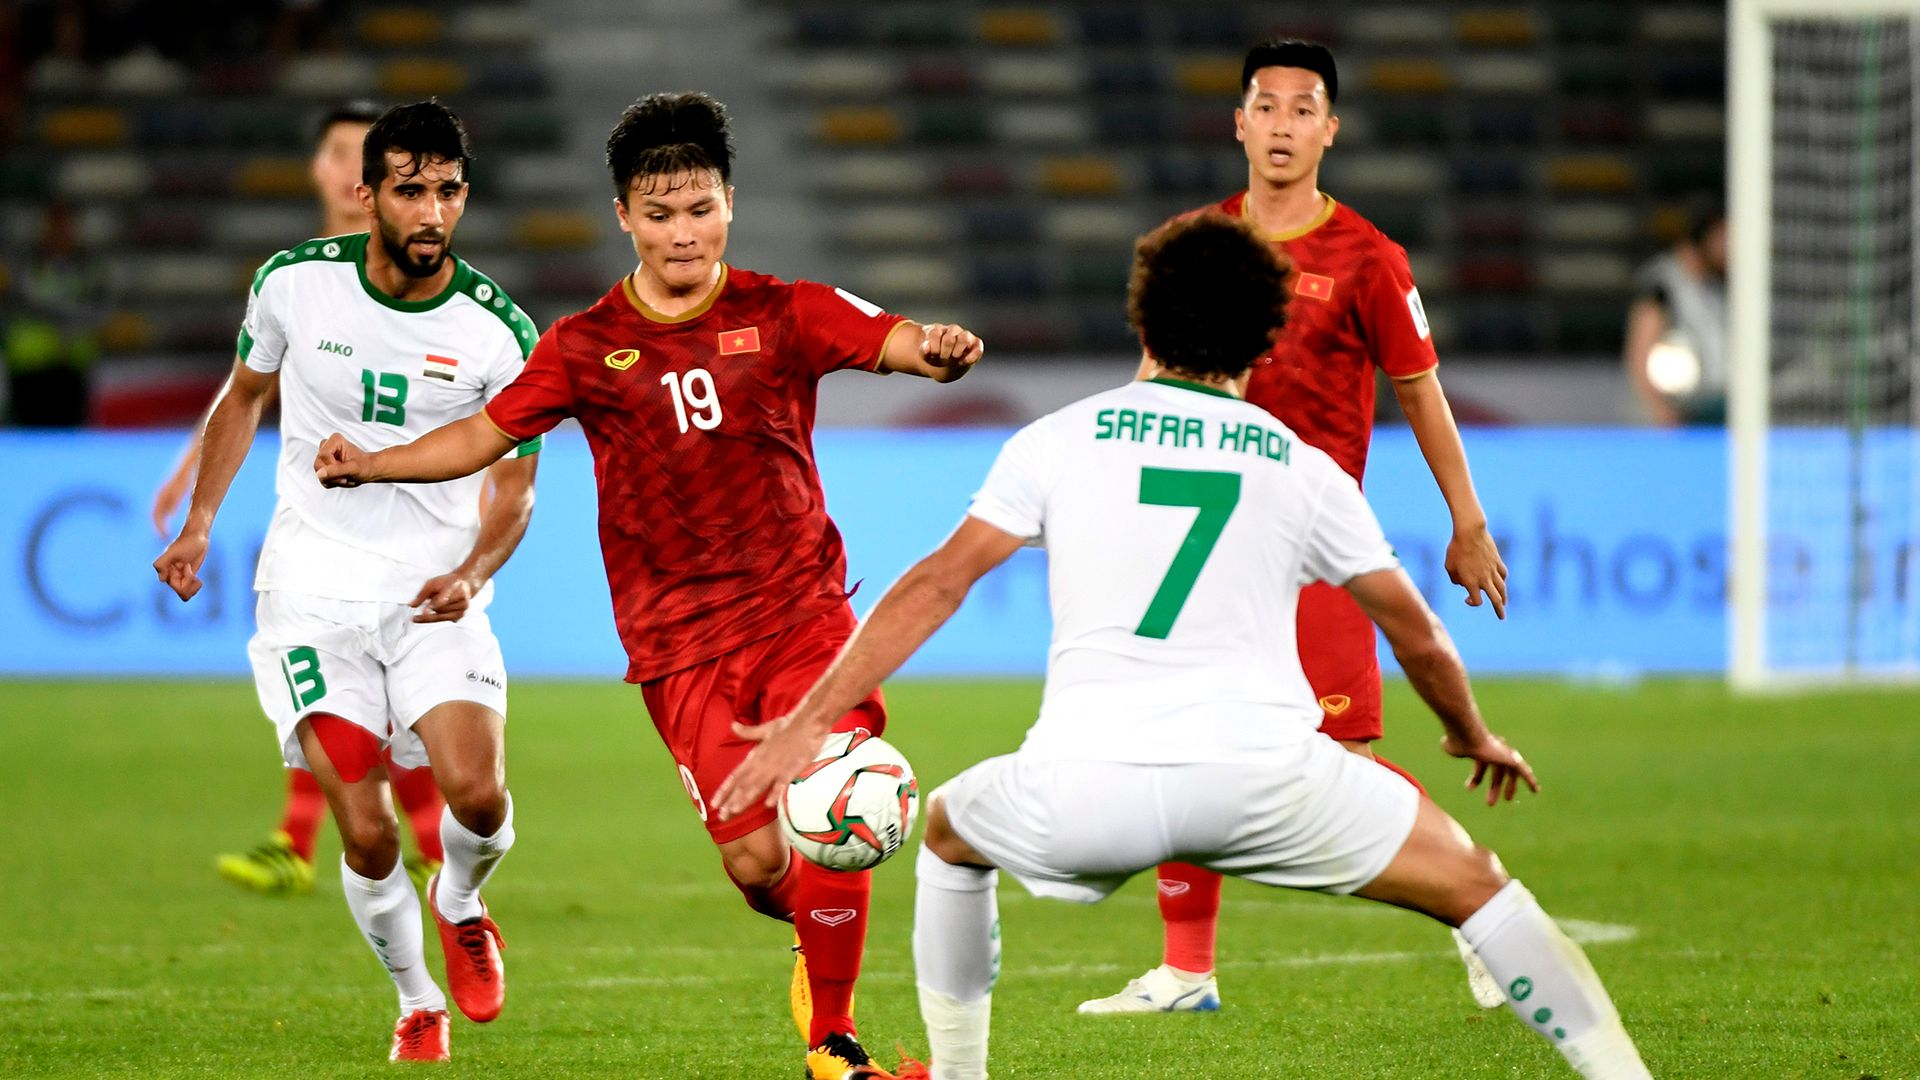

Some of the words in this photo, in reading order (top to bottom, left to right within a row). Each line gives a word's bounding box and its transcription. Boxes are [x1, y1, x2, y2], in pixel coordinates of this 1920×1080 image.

[317, 339, 353, 357] JAKO
[361, 368, 409, 427] 13
[660, 368, 723, 434] 19
[1095, 408, 1204, 449] SAFAR
[1218, 422, 1290, 466] HADI
[22, 487, 260, 628] Ca
[1134, 465, 1243, 640] 7
[281, 645, 328, 713] 13
[480, 674, 502, 690] JAKO
